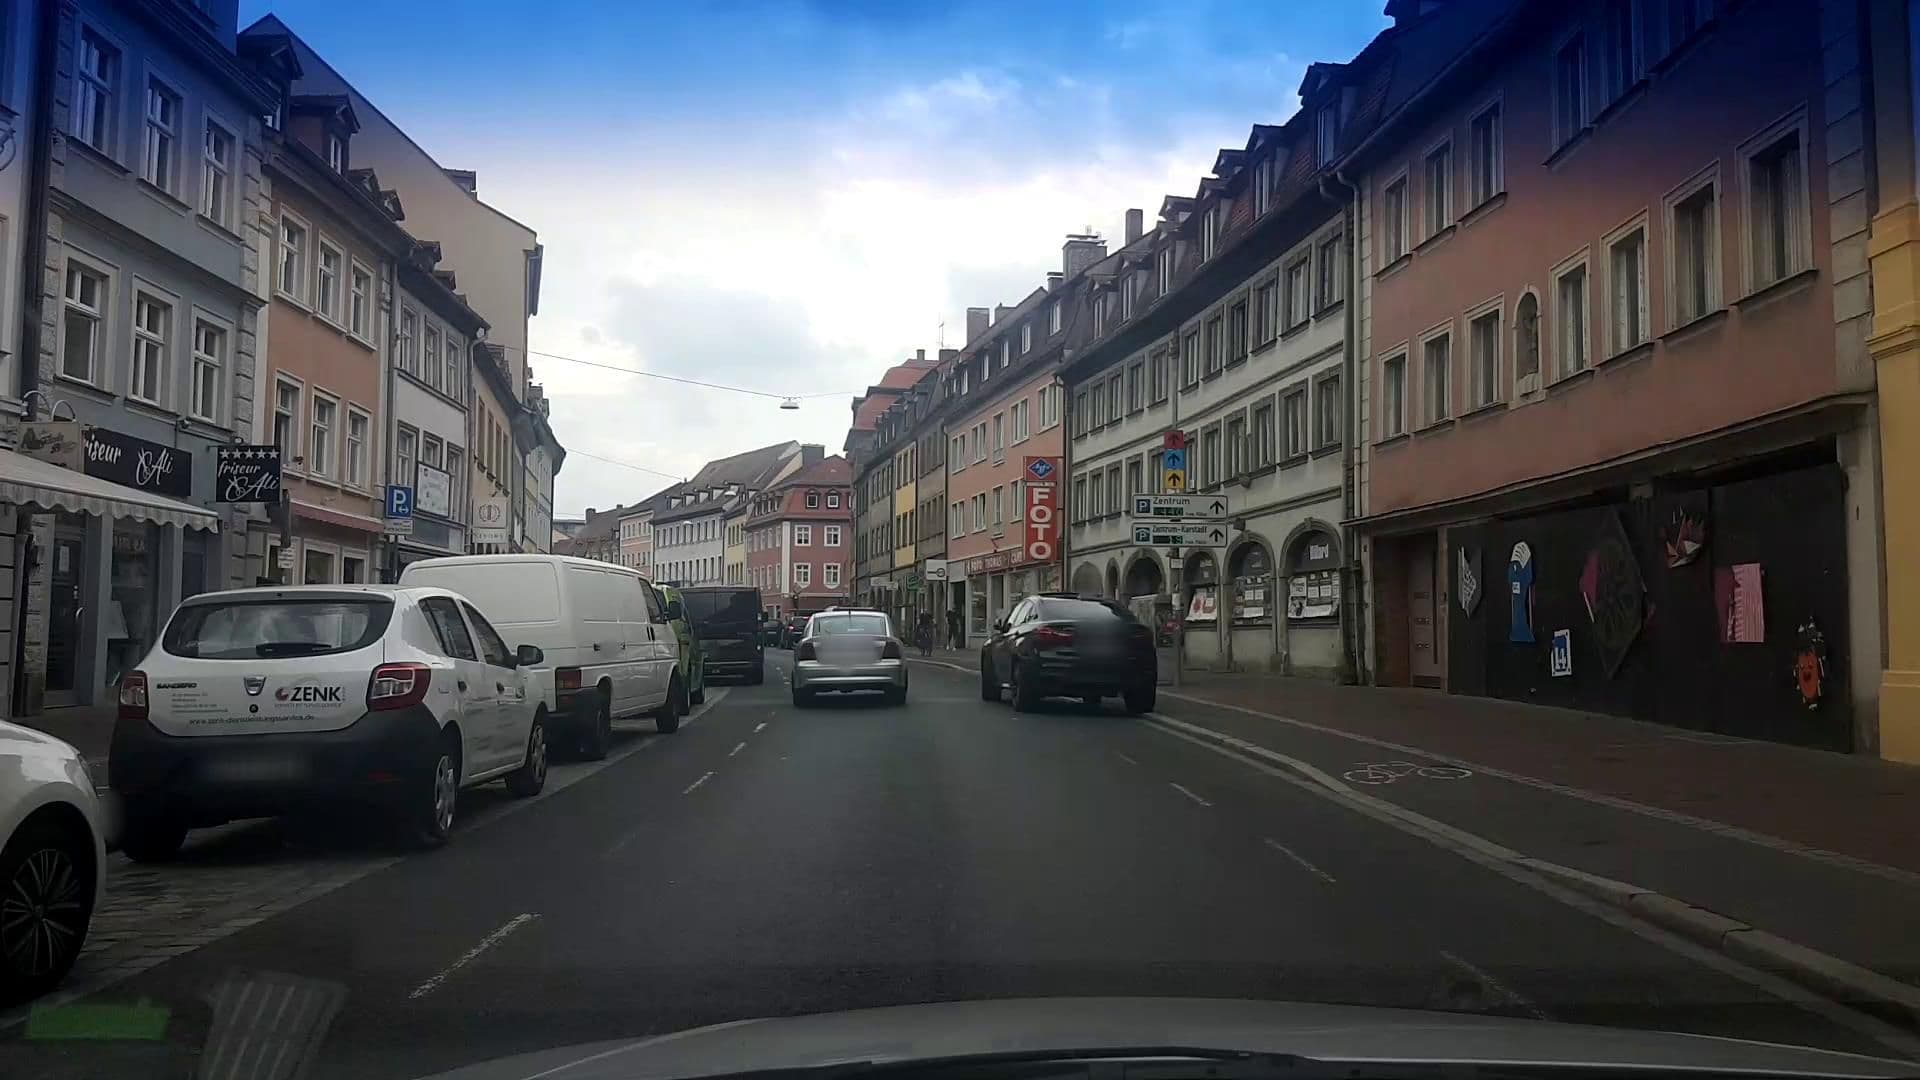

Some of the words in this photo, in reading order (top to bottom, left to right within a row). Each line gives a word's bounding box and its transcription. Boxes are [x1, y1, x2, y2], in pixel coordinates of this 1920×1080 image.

[392, 489, 406, 513] P
[1153, 497, 1190, 505] Zentrum
[1029, 487, 1052, 560] FOTO
[290, 686, 342, 702] ZENK
